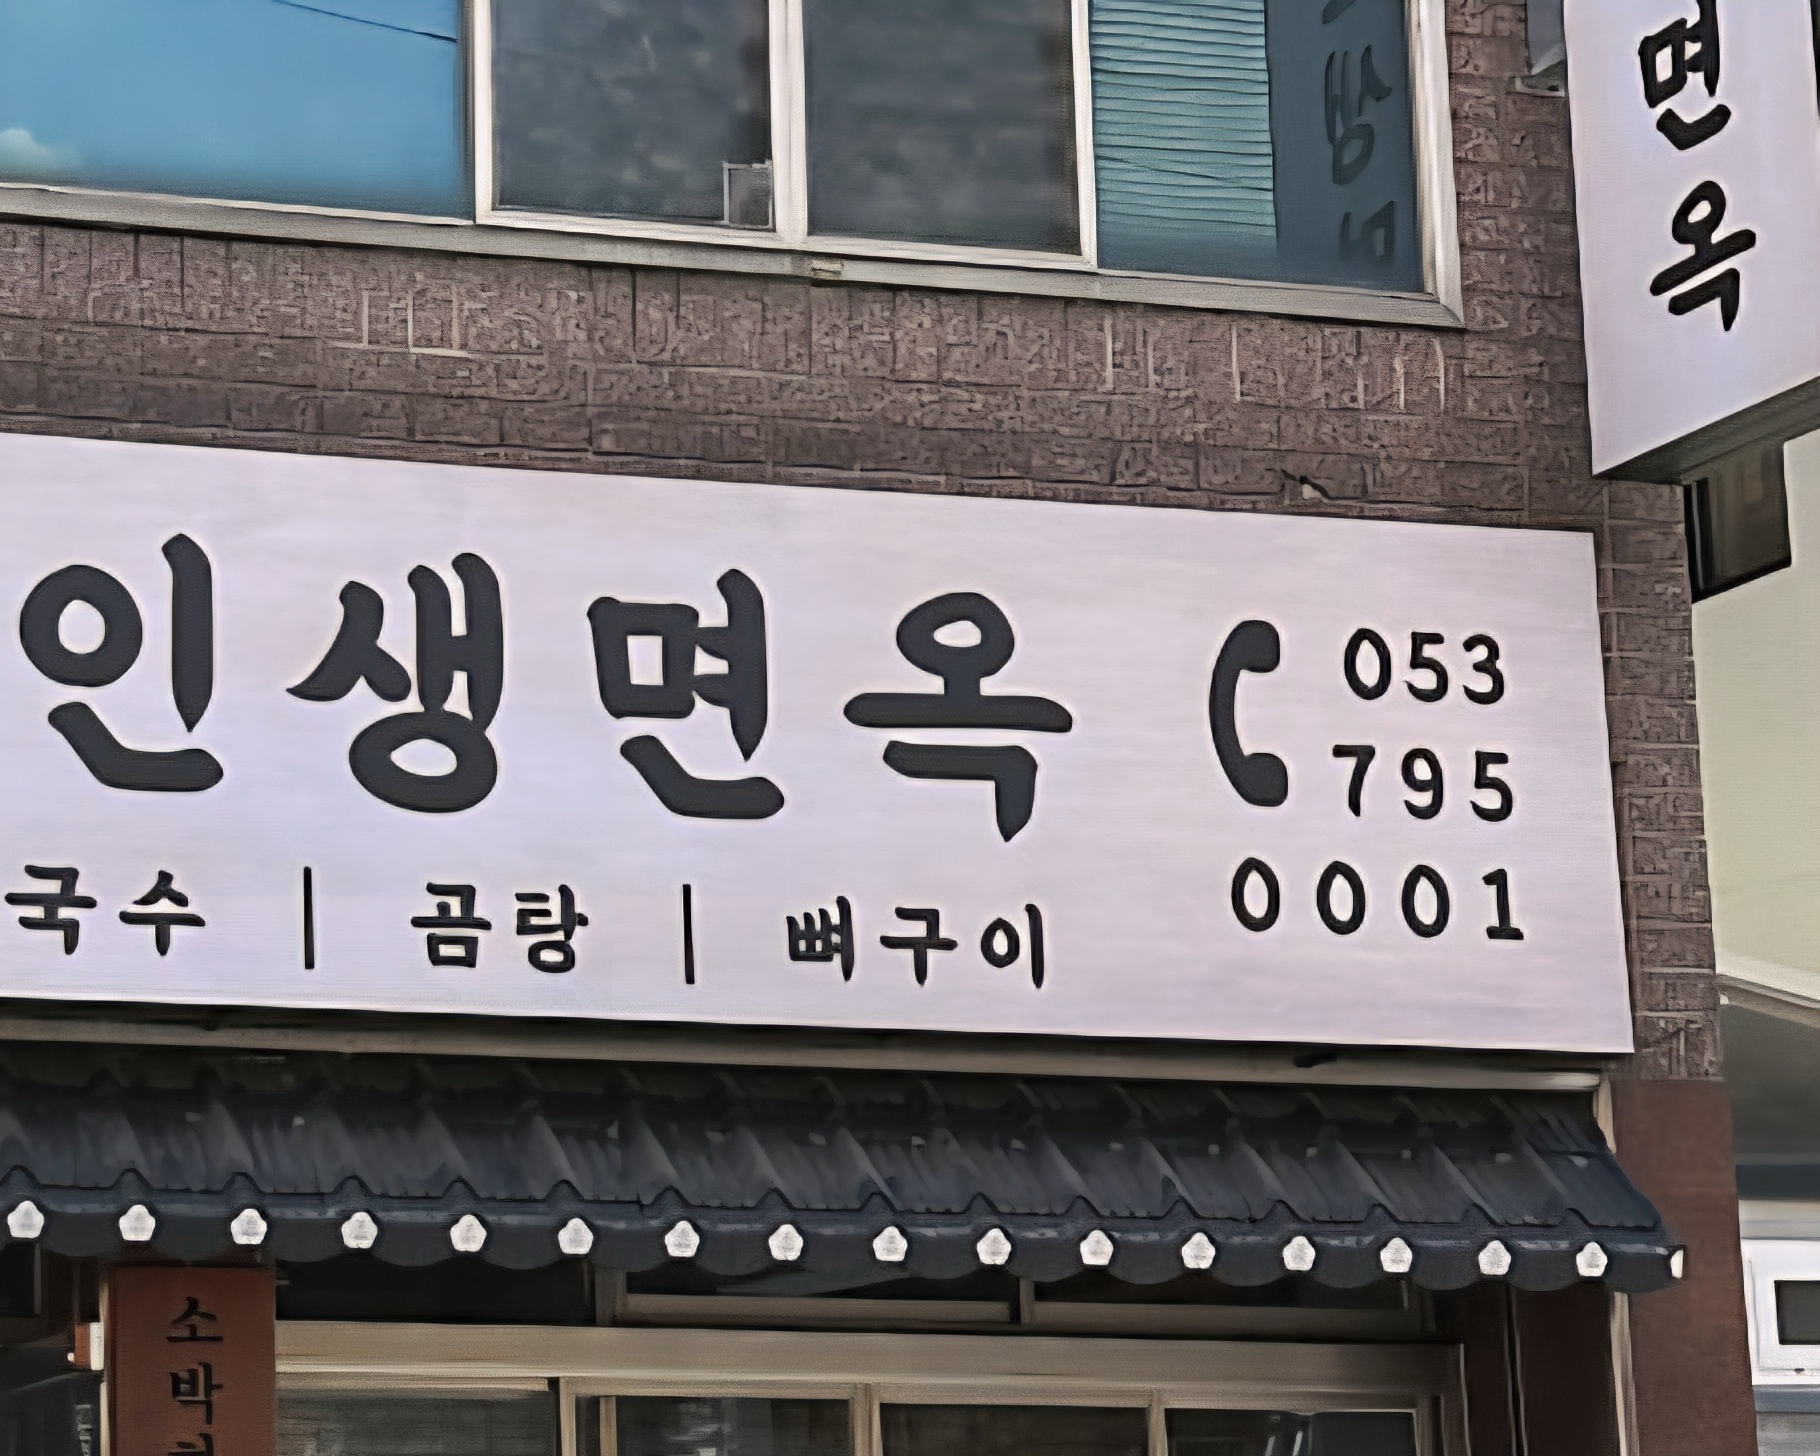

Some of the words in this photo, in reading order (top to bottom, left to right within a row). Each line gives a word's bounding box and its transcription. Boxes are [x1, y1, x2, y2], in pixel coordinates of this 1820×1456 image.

[20, 534, 1073, 842] 인생면옥
[1344, 628, 1505, 705] 053
[1333, 745, 1514, 822] 795
[411, 883, 589, 973] 곰탕
[786, 896, 1045, 988] 뼈구이
[1231, 857, 1525, 941] 0001
